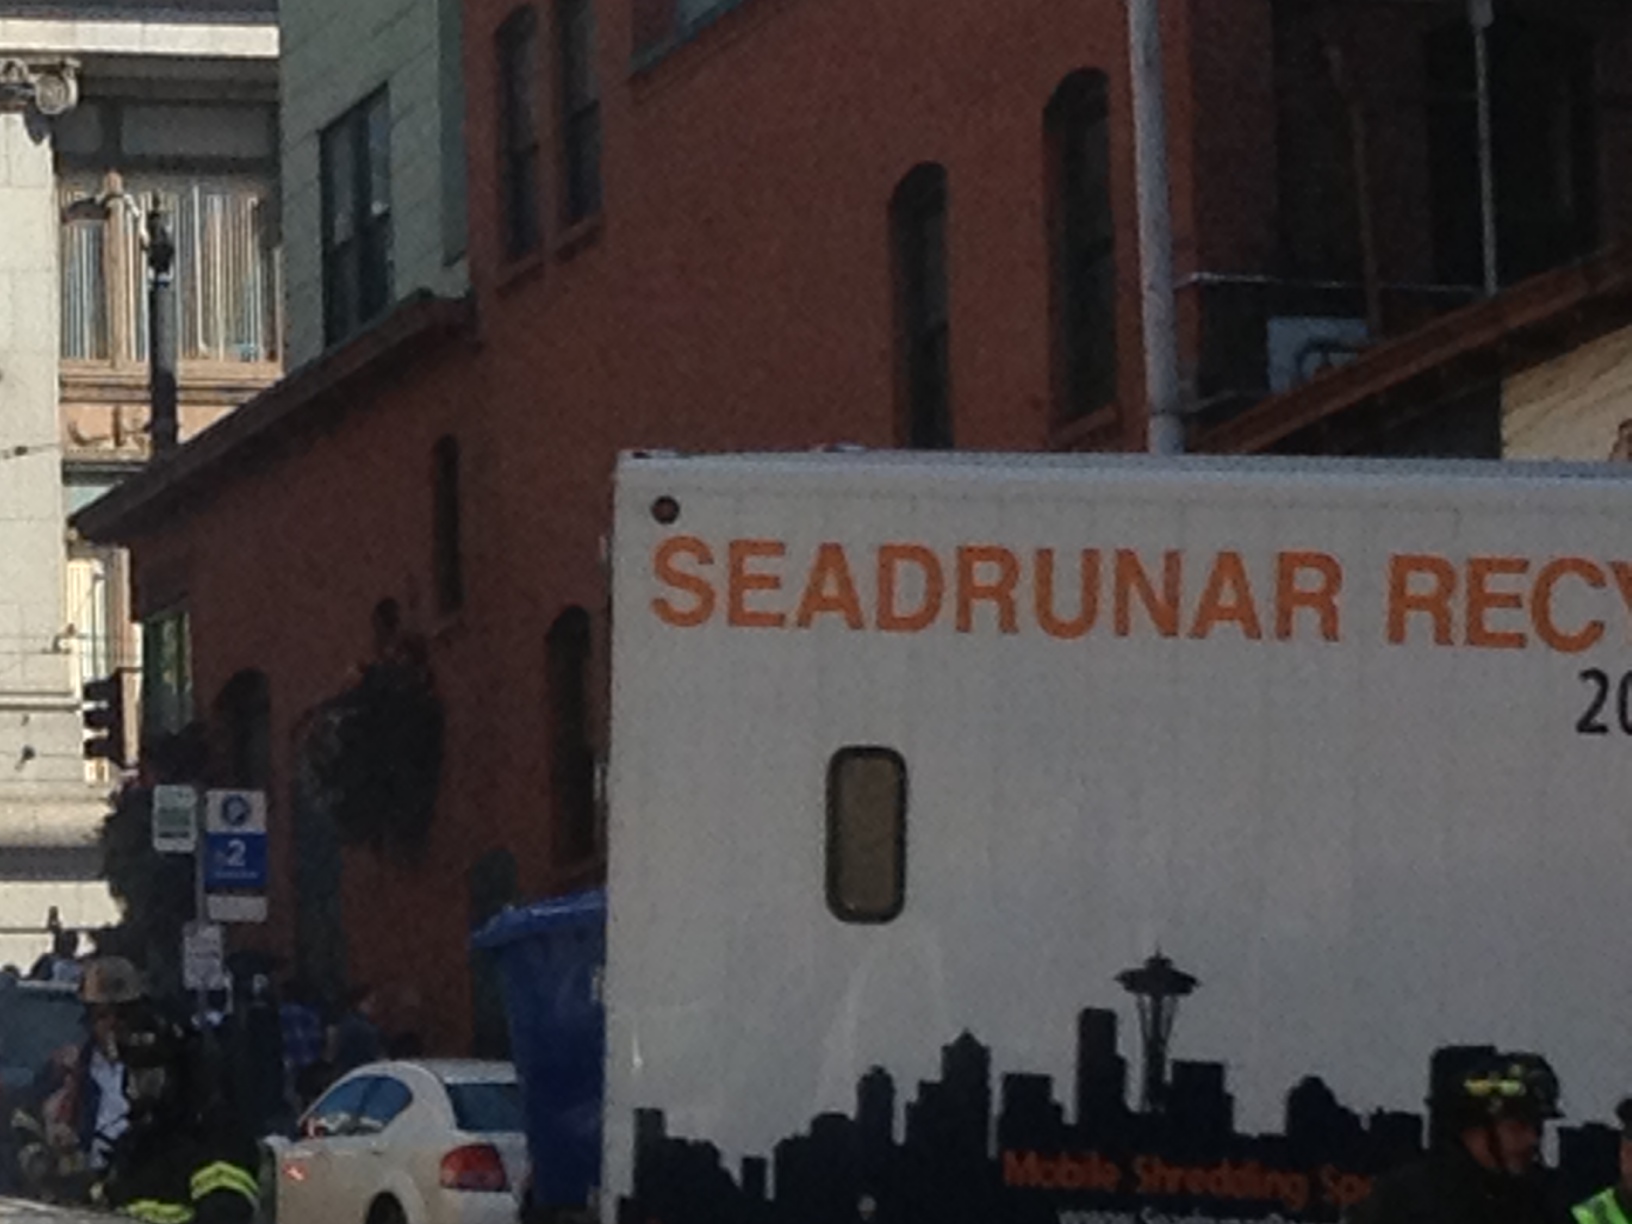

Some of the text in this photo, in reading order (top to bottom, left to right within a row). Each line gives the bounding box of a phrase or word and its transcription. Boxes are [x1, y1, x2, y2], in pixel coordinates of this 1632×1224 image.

[651, 534, 1344, 643] SEADRUNAR
[227, 838, 247, 867] 2
[1003, 1148, 1121, 1191] Mobile
[1132, 1152, 1309, 1211] Shredding
